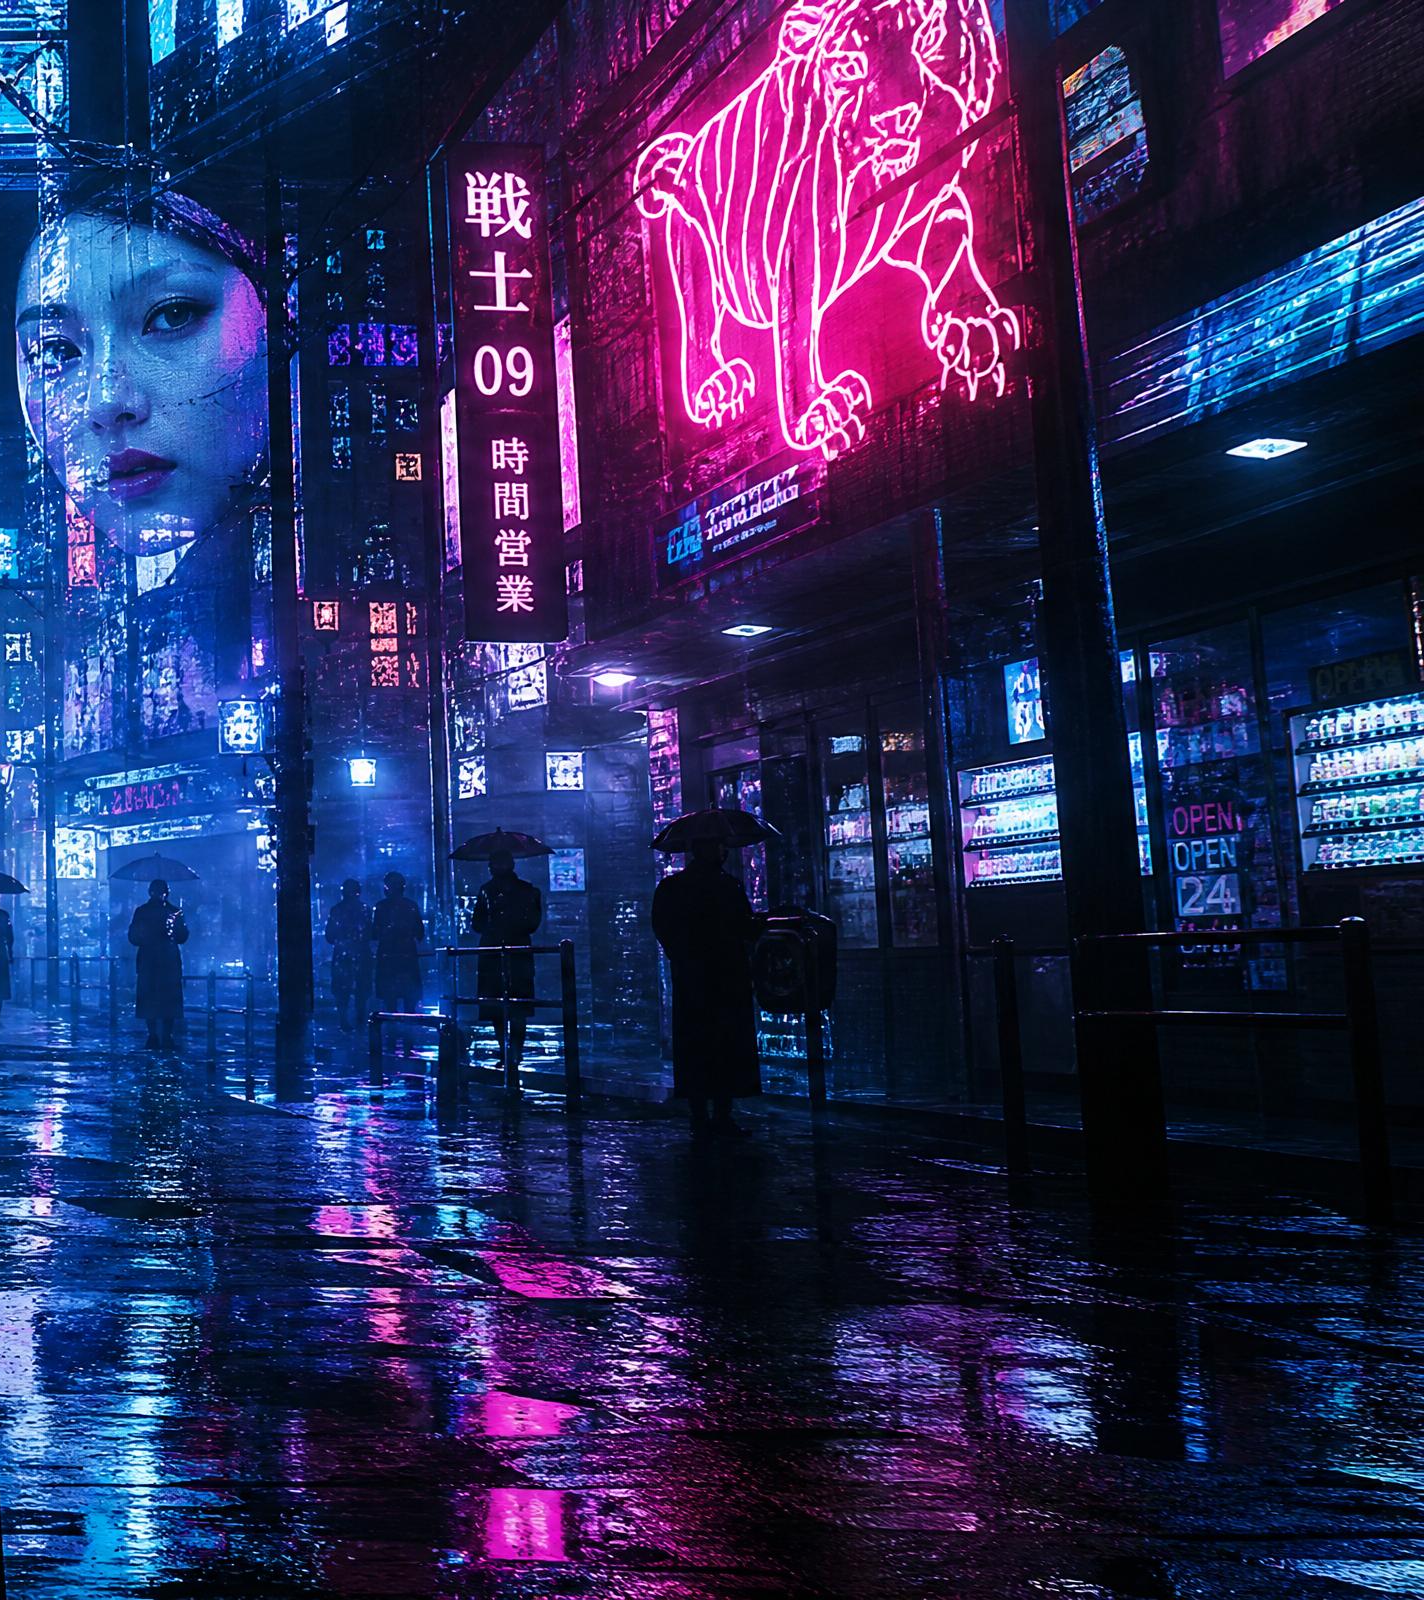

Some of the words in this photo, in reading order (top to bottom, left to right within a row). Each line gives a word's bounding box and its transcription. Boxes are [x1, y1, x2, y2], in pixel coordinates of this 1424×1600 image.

[464, 171, 533, 312] 戦士
[473, 345, 534, 397] 09
[491, 437, 534, 612] 時間営業
[1173, 801, 1234, 836] OPEN
[1173, 837, 1237, 871] OPEN
[1181, 874, 1236, 915] 24
